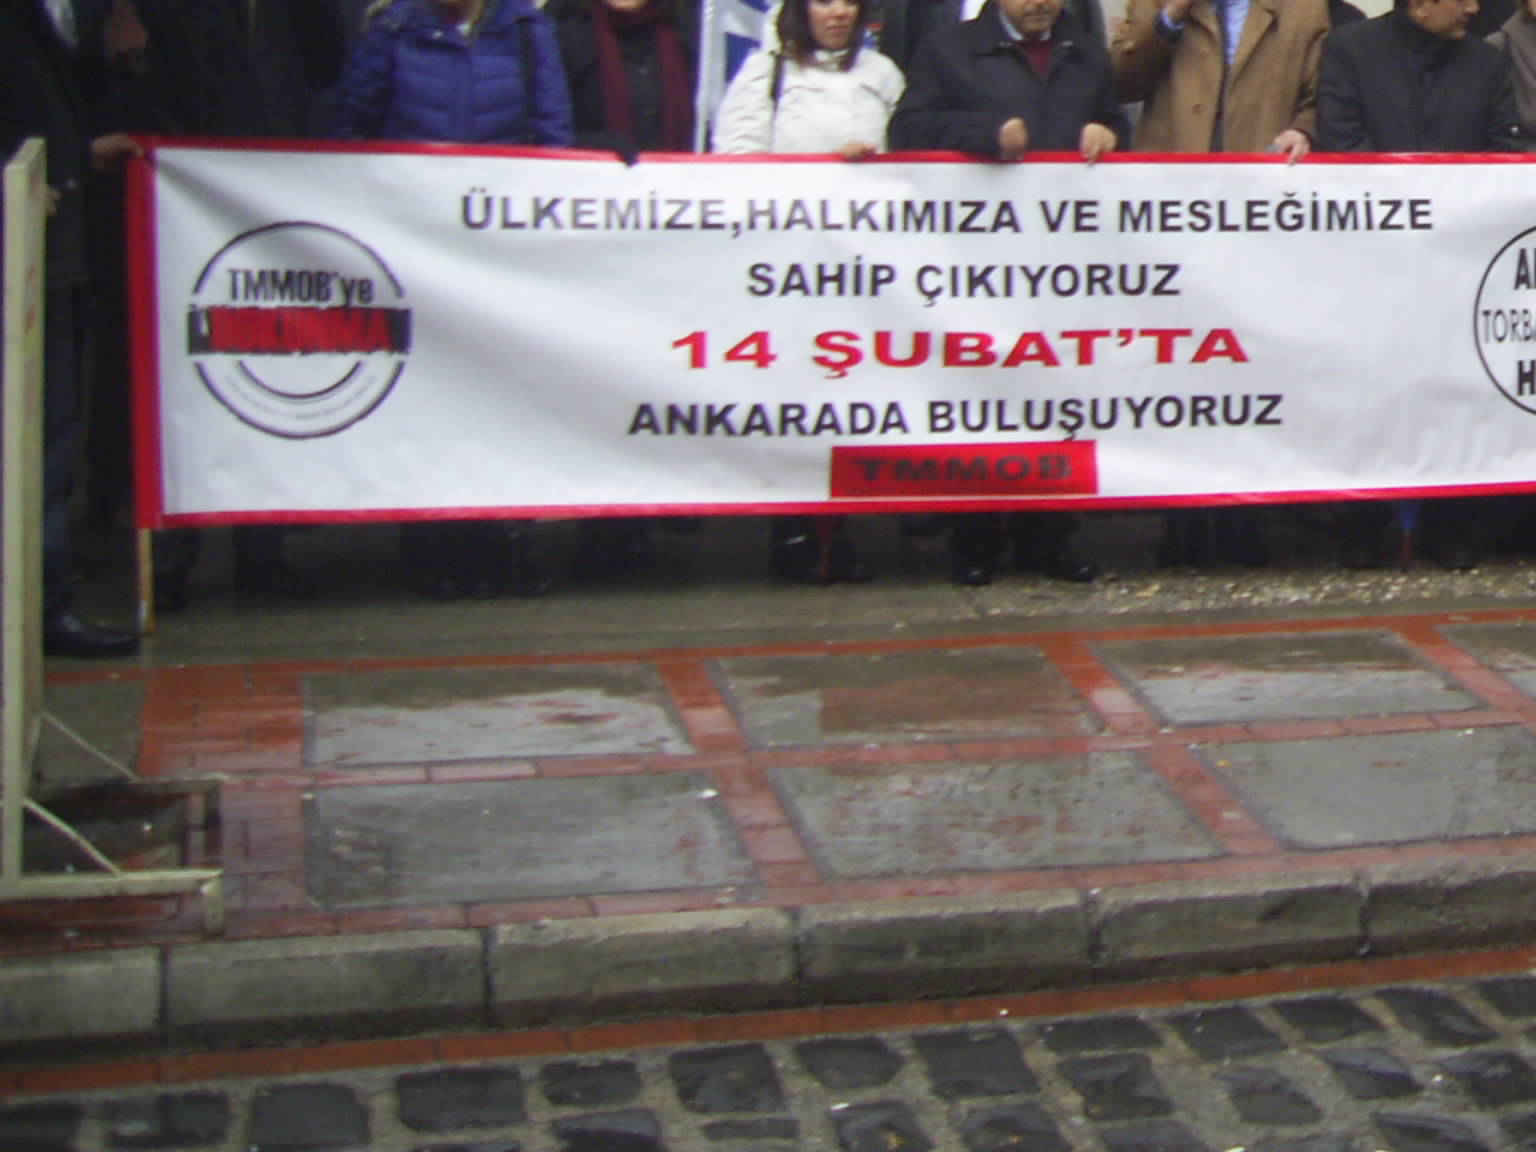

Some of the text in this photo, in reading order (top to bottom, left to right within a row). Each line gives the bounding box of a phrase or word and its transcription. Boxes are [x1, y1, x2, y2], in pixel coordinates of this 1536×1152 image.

[1040, 199, 1100, 233] VE
[1118, 191, 1434, 233] MESLEĞİMİZE
[747, 254, 1182, 308] SAHİP ÇIKIYORUZ
[671, 330, 777, 370] 14
[628, 394, 1284, 442] ANKARADA BULUŞUYORUZ
[855, 453, 1073, 483] TMMOB
